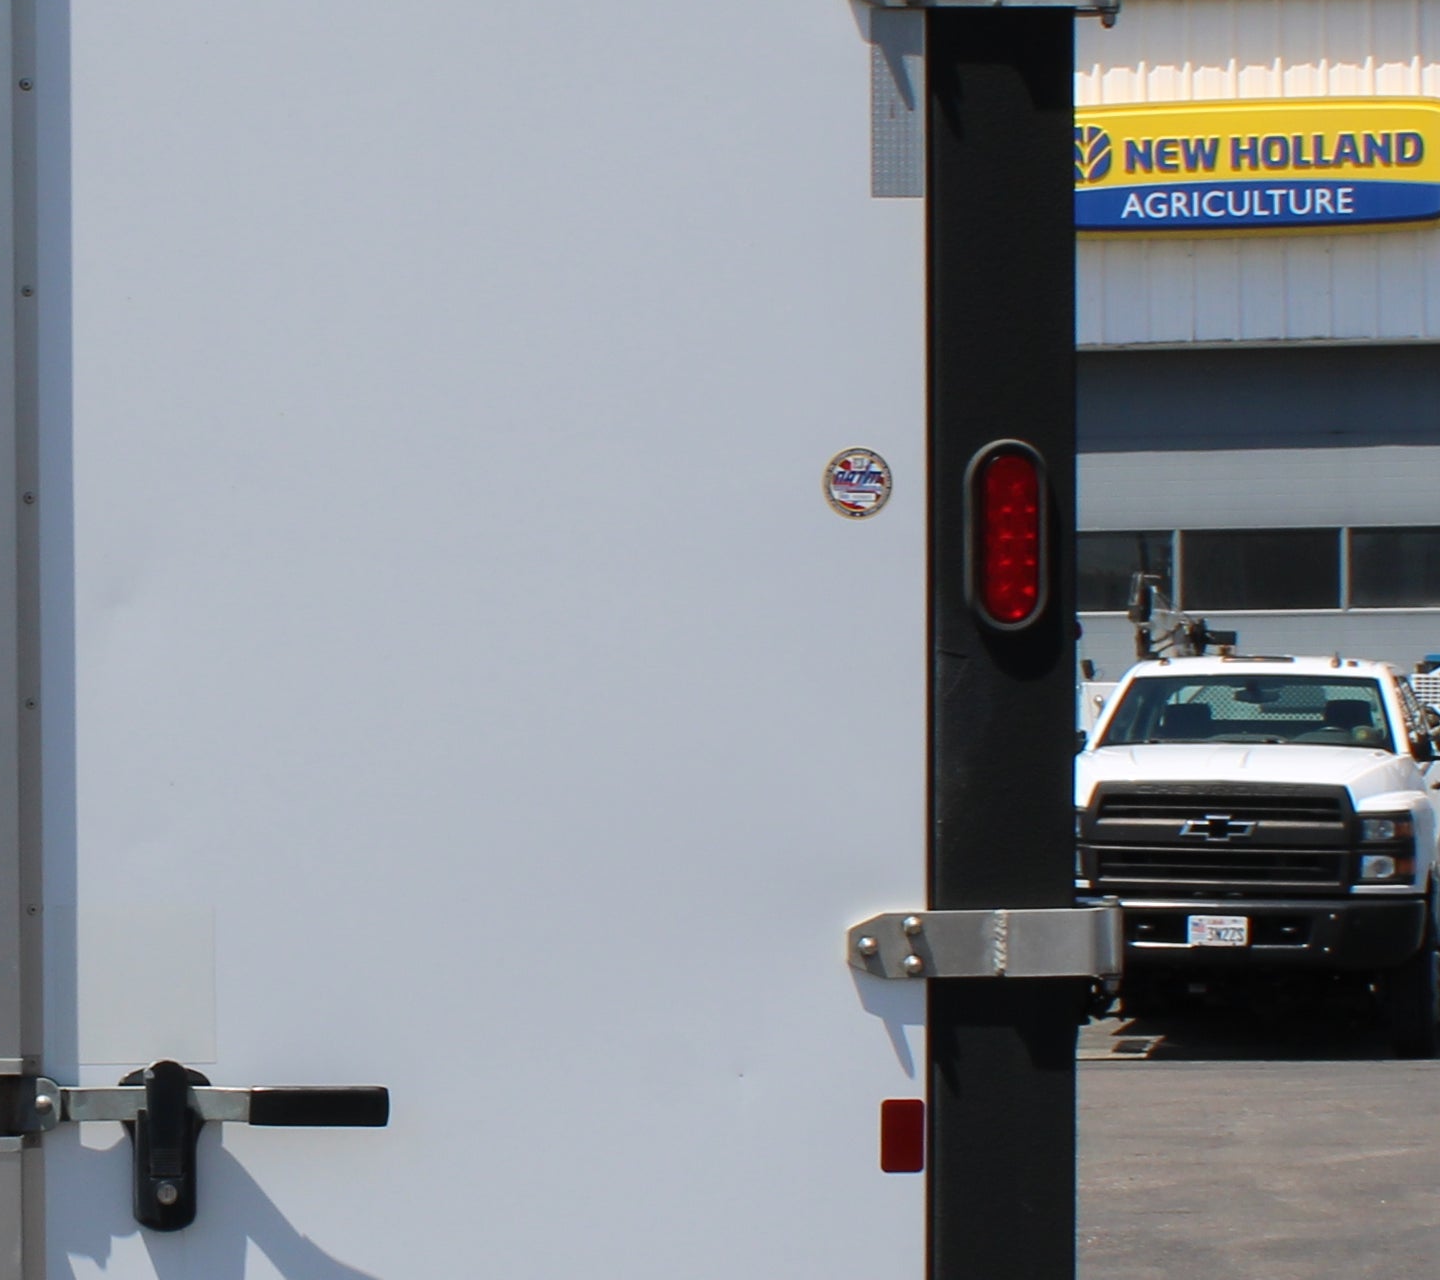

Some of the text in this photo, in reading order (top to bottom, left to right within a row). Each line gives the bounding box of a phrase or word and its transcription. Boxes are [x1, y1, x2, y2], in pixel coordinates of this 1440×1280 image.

[1123, 130, 1424, 174] NEW HOLLAND
[1121, 188, 1354, 219] AGRICULTURE
